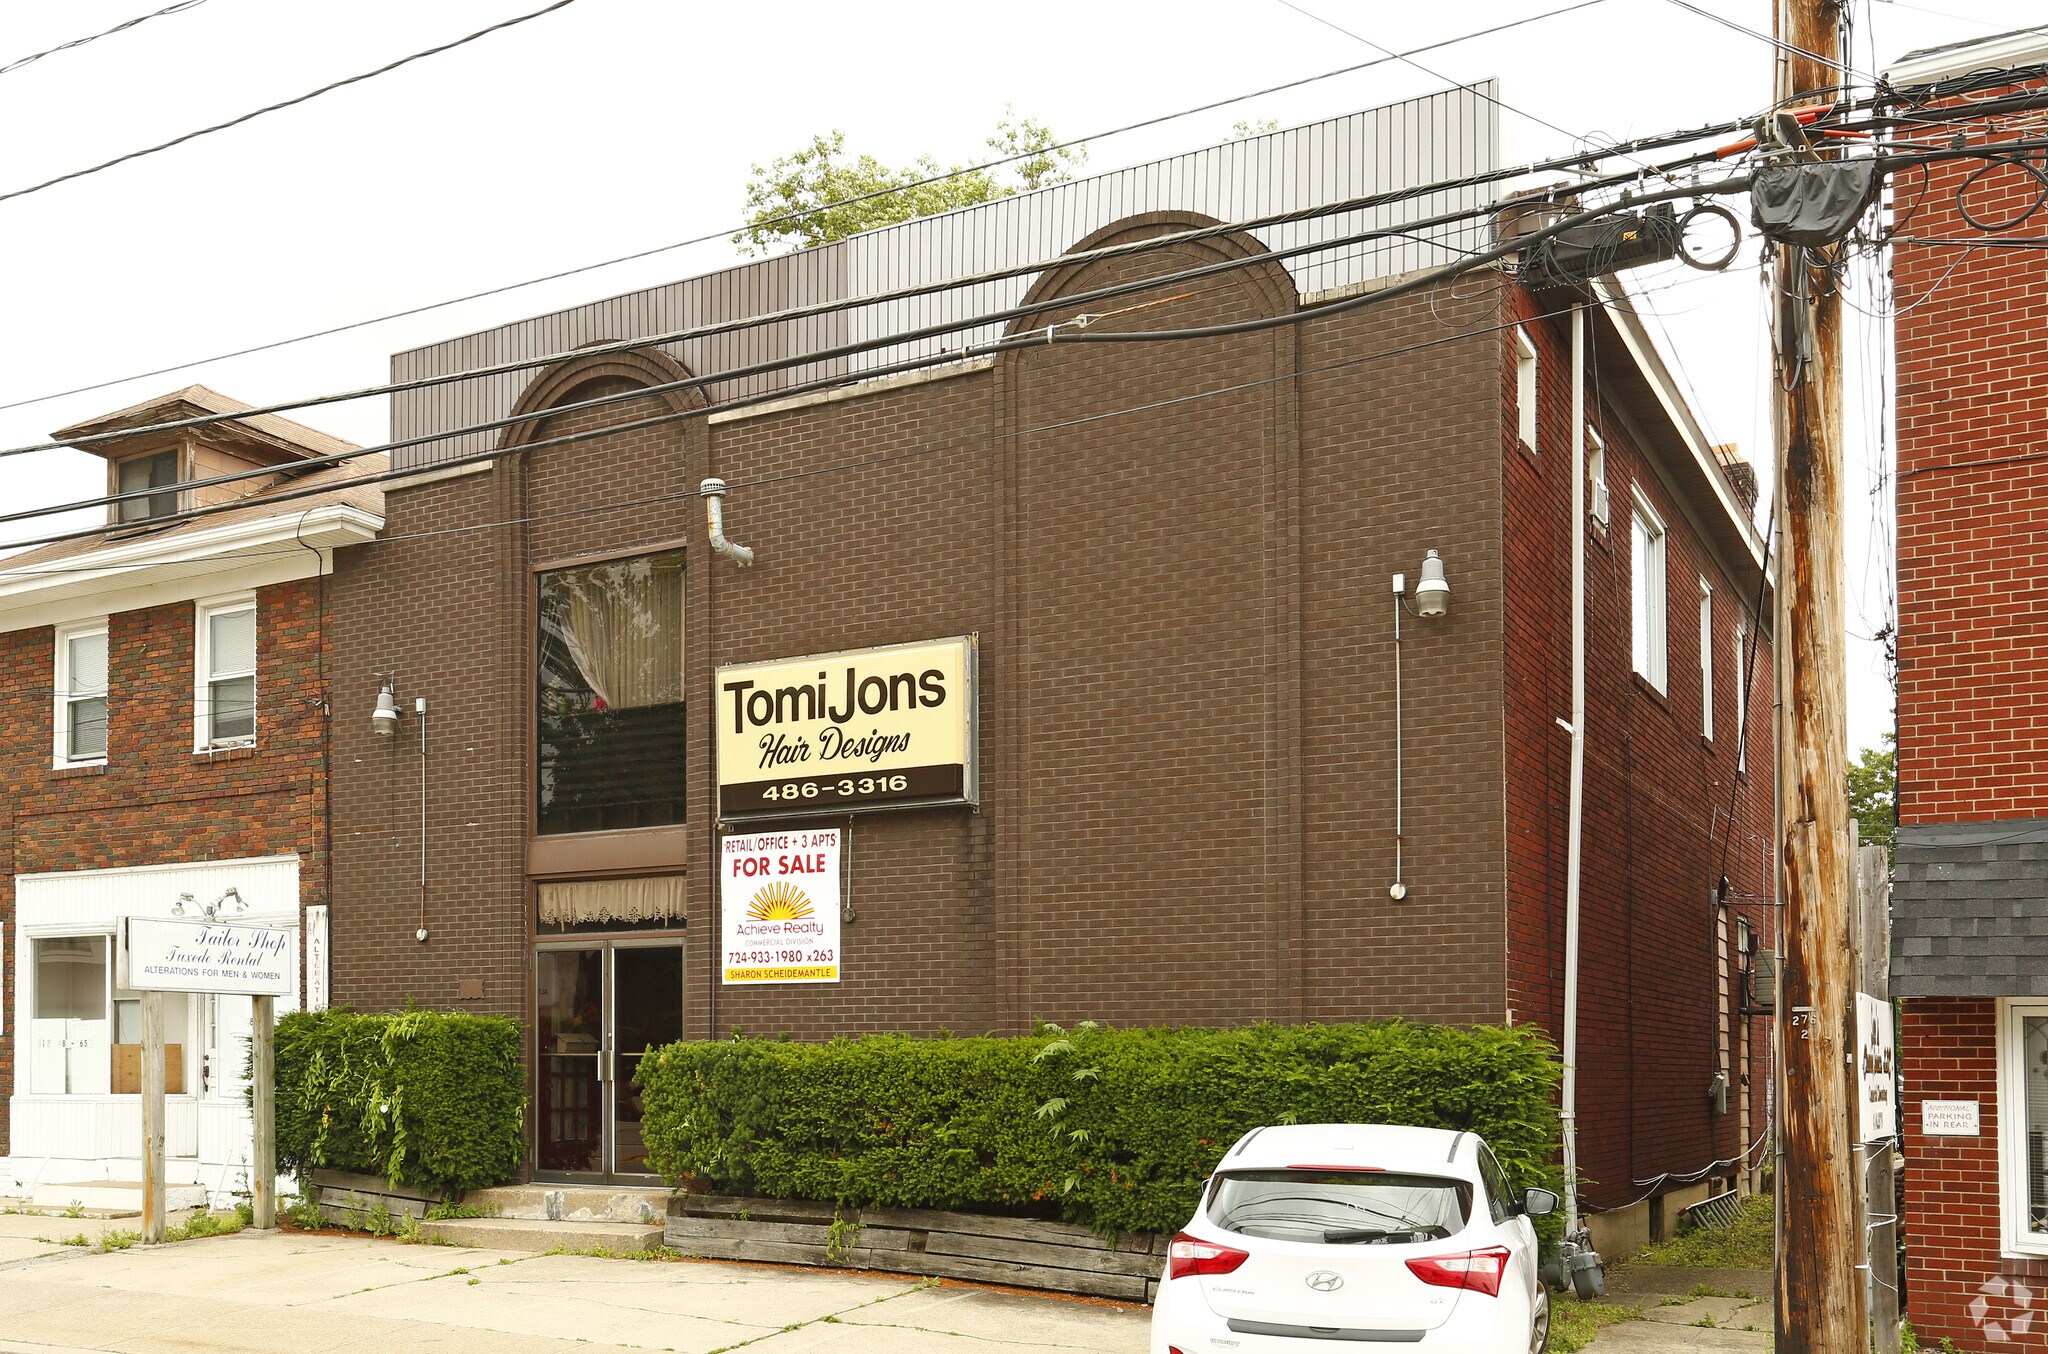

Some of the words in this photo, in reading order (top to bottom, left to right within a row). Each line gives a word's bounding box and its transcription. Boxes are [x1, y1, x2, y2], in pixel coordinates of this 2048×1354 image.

[724, 668, 946, 734] TomiJons
[758, 733, 811, 769] Hair
[818, 726, 911, 763] Designs
[762, 775, 908, 801] 486-3316
[725, 836, 789, 853] RETAIL/OFFICE
[792, 837, 797, 846] +
[801, 834, 808, 848] 3
[811, 833, 836, 847] APTS
[733, 857, 770, 877] FOR
[778, 853, 826, 875] SALE
[736, 924, 781, 936] Achieve
[783, 921, 824, 936] Realty
[195, 925, 240, 948] Tailor
[248, 929, 286, 957] Shop
[745, 938, 783, 947] COMMERCIAL
[785, 937, 814, 945] DIVISION
[165, 945, 212, 964] Tuxedo
[217, 949, 264, 967] Rental
[728, 950, 803, 964] 724-933-1980
[806, 949, 834, 962] x263
[144, 965, 199, 976] ALTERATIONS
[202, 968, 219, 977] FOR
[221, 969, 239, 978] MEN
[242, 970, 248, 979] &
[251, 971, 281, 980] WOMEN
[730, 969, 762, 979] SHARON
[764, 968, 831, 979] SCHEIDEMANTLE
[1927, 1104, 1970, 1112] ADDITIONAL
